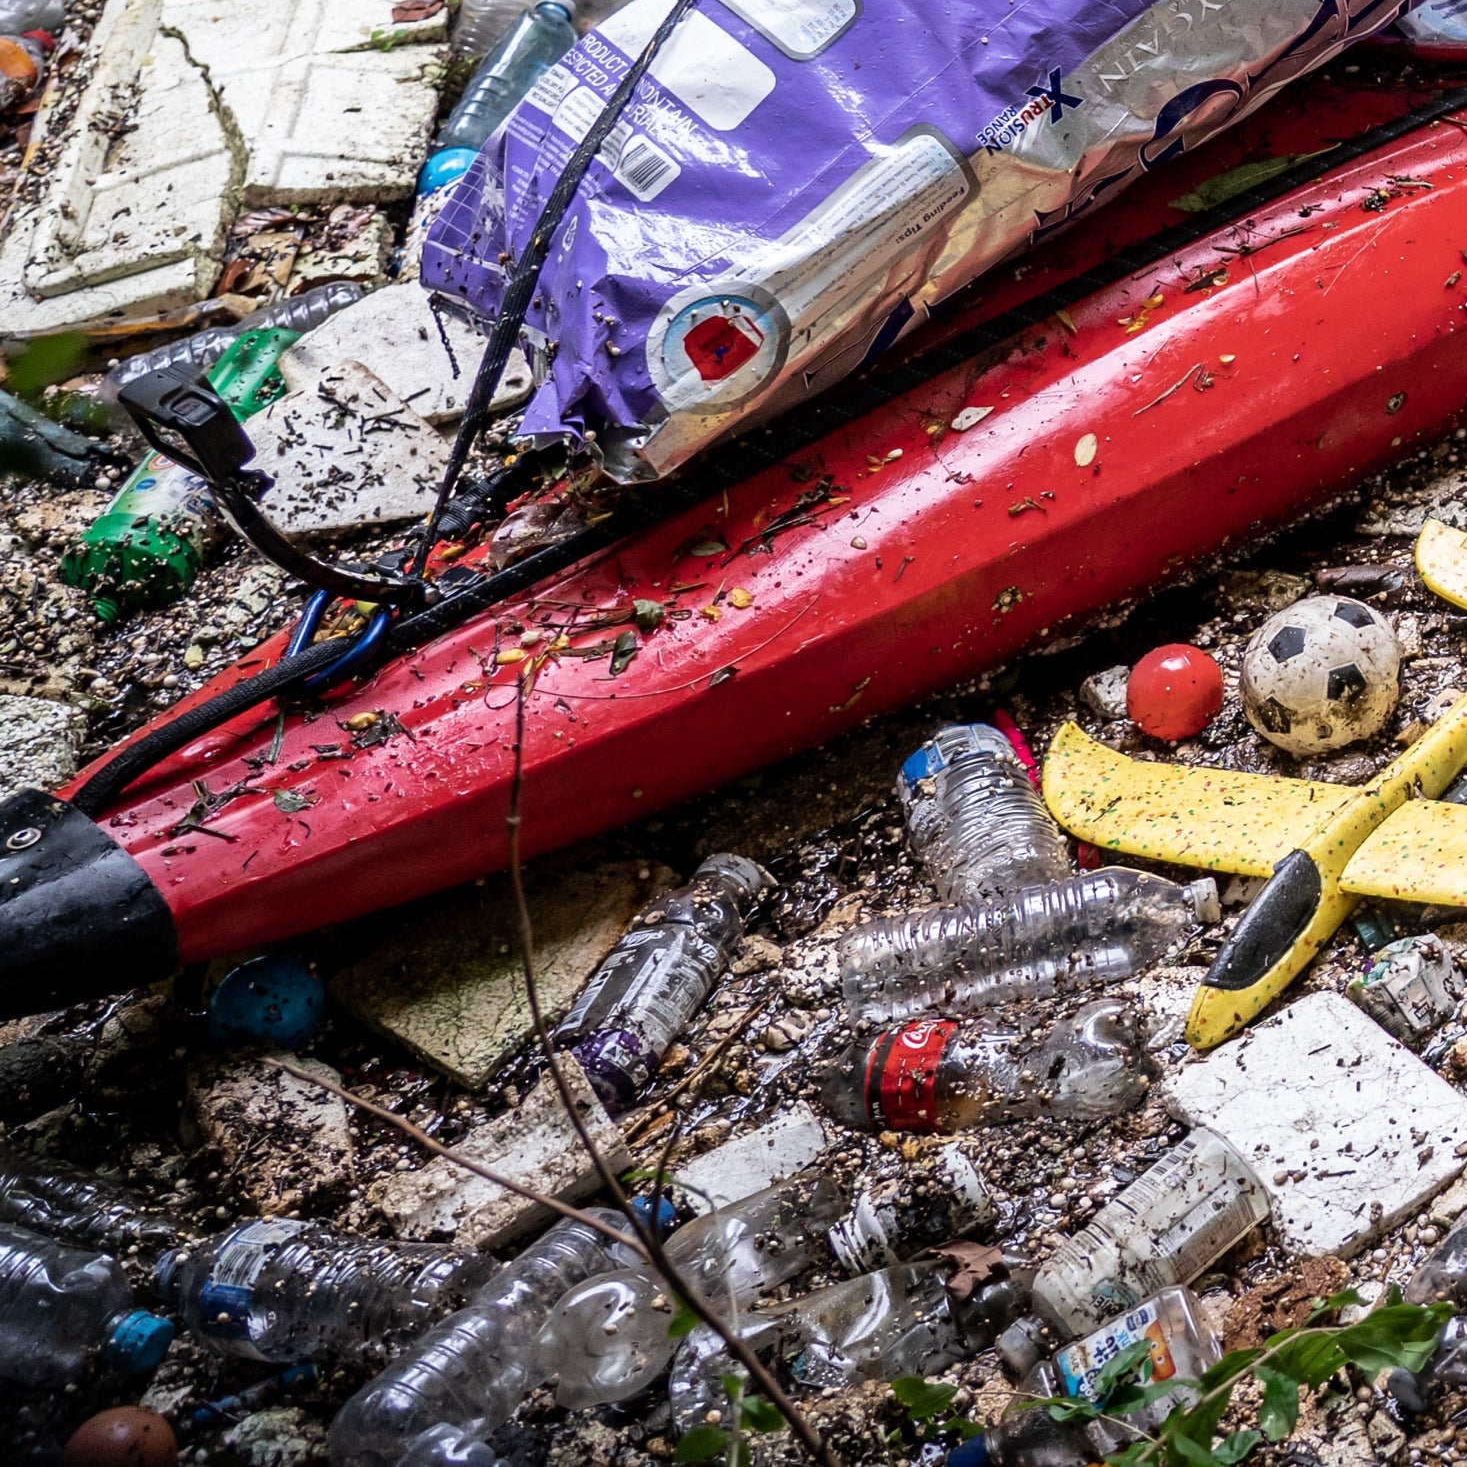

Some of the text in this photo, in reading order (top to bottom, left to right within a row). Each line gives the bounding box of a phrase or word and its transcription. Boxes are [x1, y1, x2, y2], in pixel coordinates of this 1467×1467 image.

[977, 105, 1017, 145] RANGE
[986, 66, 1085, 156] XTRUSION
[895, 186, 965, 245] Feeding Tips:
